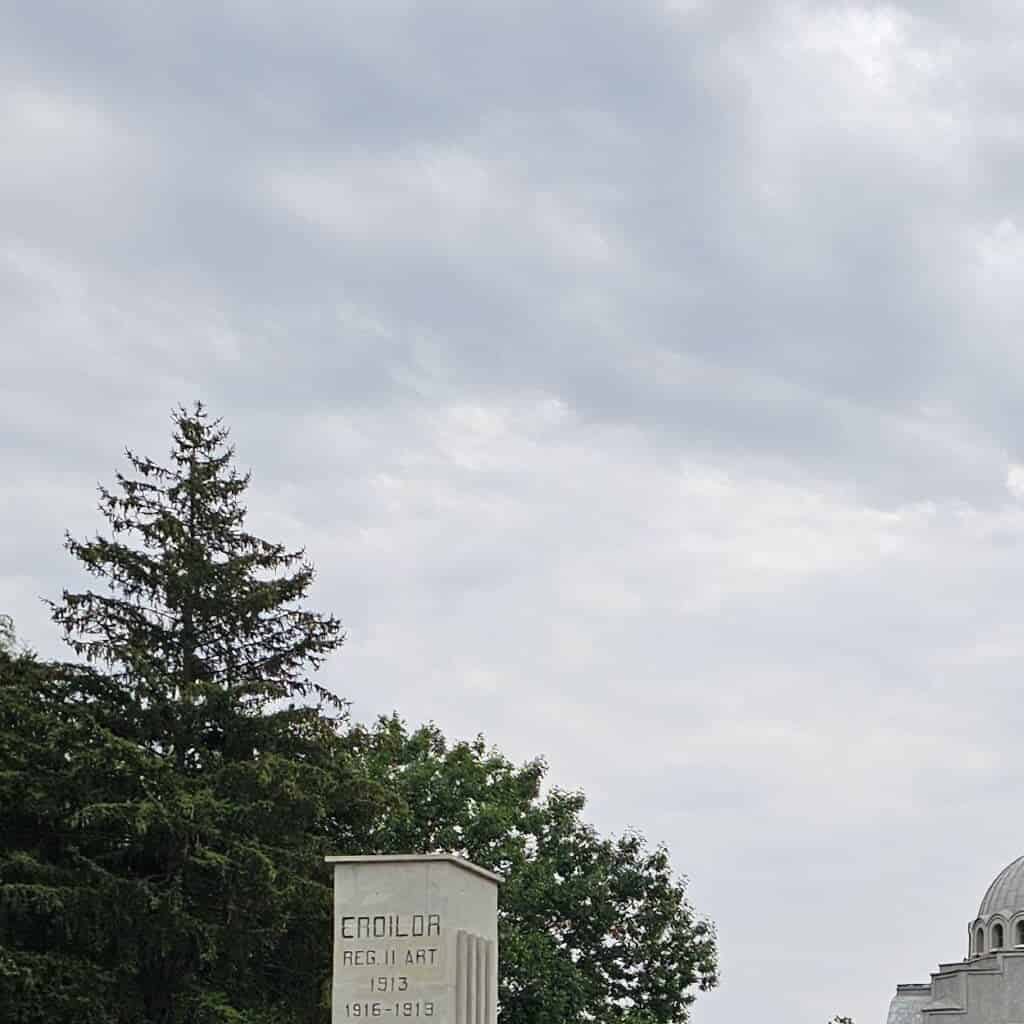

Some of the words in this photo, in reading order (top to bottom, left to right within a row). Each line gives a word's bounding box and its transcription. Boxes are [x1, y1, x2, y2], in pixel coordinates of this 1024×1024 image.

[342, 914, 441, 939] EROILOR
[343, 950, 380, 966] REG.
[370, 976, 409, 992] 1913
